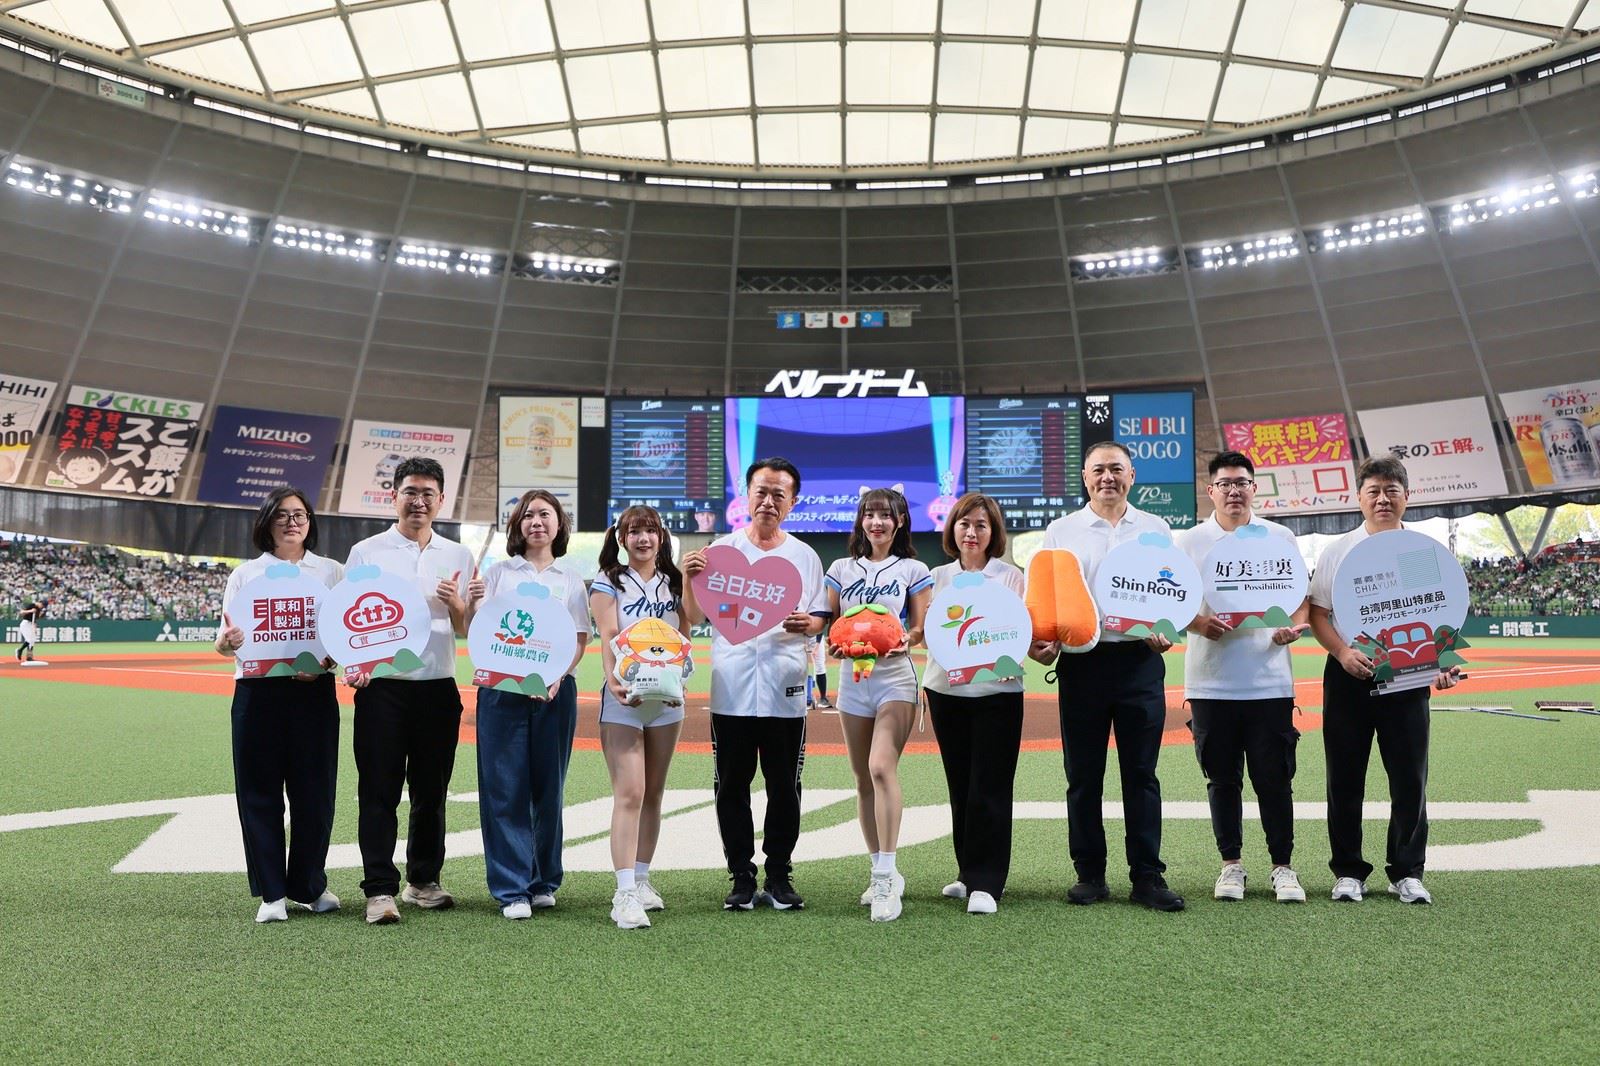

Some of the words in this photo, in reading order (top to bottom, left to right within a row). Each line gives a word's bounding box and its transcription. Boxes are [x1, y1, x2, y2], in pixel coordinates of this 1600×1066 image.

[765, 369, 929, 397] ベルーナドーム
[0, 430, 33, 447] 00
[237, 425, 312, 444] MIZUHO
[1252, 421, 1318, 447] 無料
[101, 417, 154, 493] ススム
[1127, 441, 1181, 459] SOGO
[1240, 440, 1344, 467] バイキング
[1389, 437, 1484, 459] 家の正解。
[1549, 439, 1592, 458] Asahi
[137, 422, 197, 496] ご飯が
[1447, 482, 1478, 491] HAUS
[707, 571, 786, 605] 台日友好
[841, 578, 901, 603] Angels
[1111, 576, 1145, 592] Shin
[1244, 583, 1294, 591] Possibilities.
[1355, 580, 1398, 594] CHIAYUM
[274, 600, 301, 613] 東和
[1359, 590, 1446, 616] 台湾阿里山特産品
[274, 614, 301, 629] 製油
[305, 596, 316, 640] 百年老店
[1361, 603, 1447, 625] ブランドプロモーションデー
[253, 632, 287, 643] DONG
[290, 631, 305, 641] HE
[1503, 621, 1549, 636] 関電工
[490, 643, 549, 663] 中埔鄉農會
